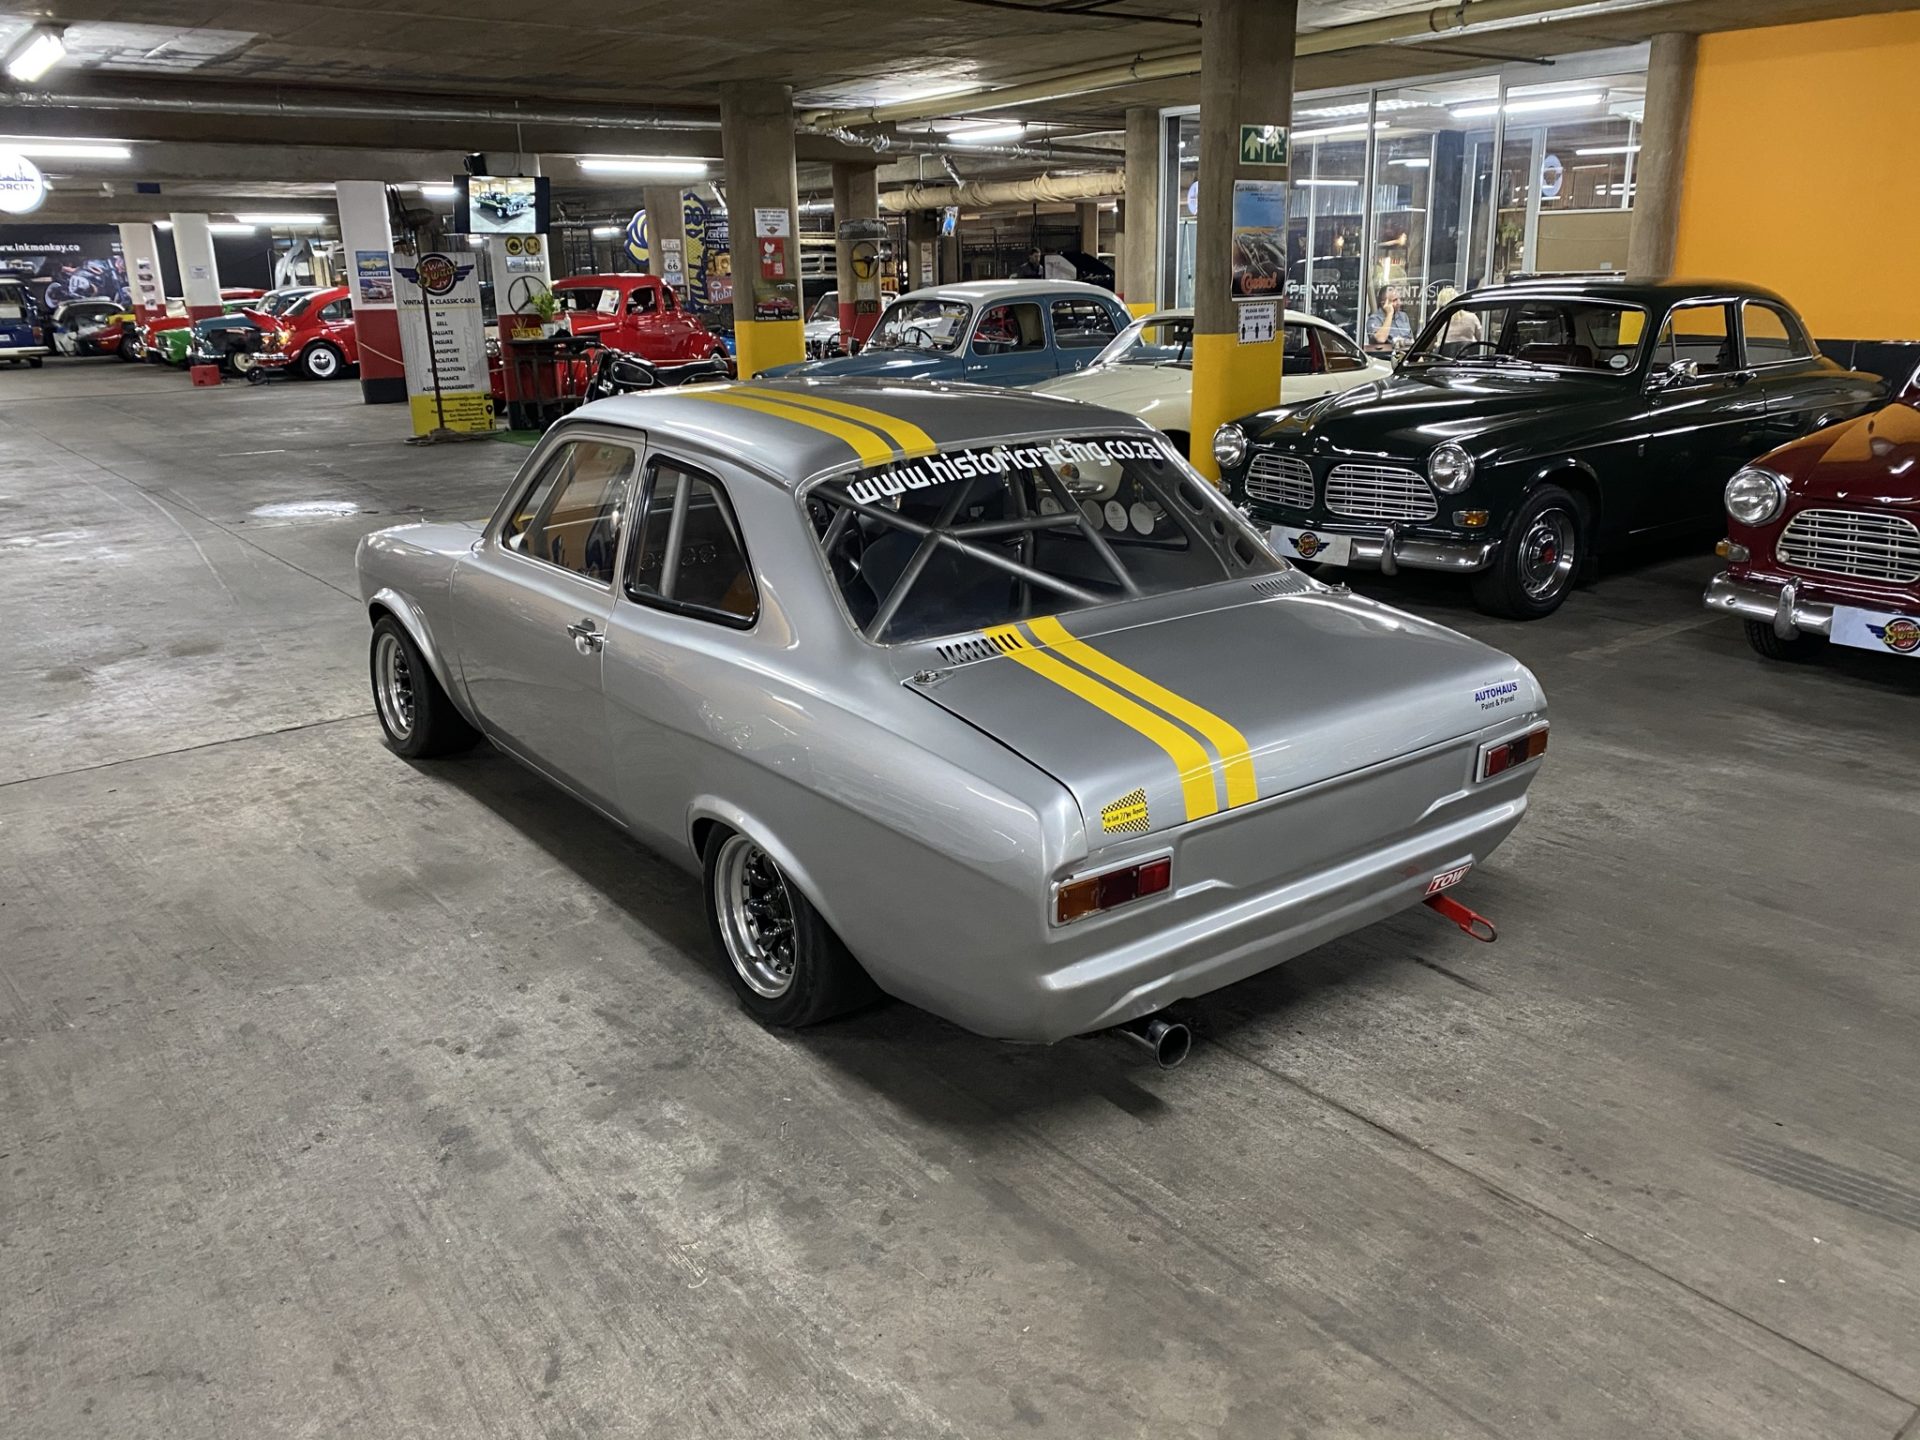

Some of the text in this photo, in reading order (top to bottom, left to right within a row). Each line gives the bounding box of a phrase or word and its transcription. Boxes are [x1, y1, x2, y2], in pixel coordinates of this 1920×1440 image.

[710, 290, 732, 303] Mobi
[1290, 284, 1338, 294] PENTA
[1386, 284, 1461, 298] PENTASU
[847, 440, 1162, 504] www.historicracing.co.za
[1475, 682, 1518, 702] AUTOHAUS
[1433, 867, 1469, 890] TOW
